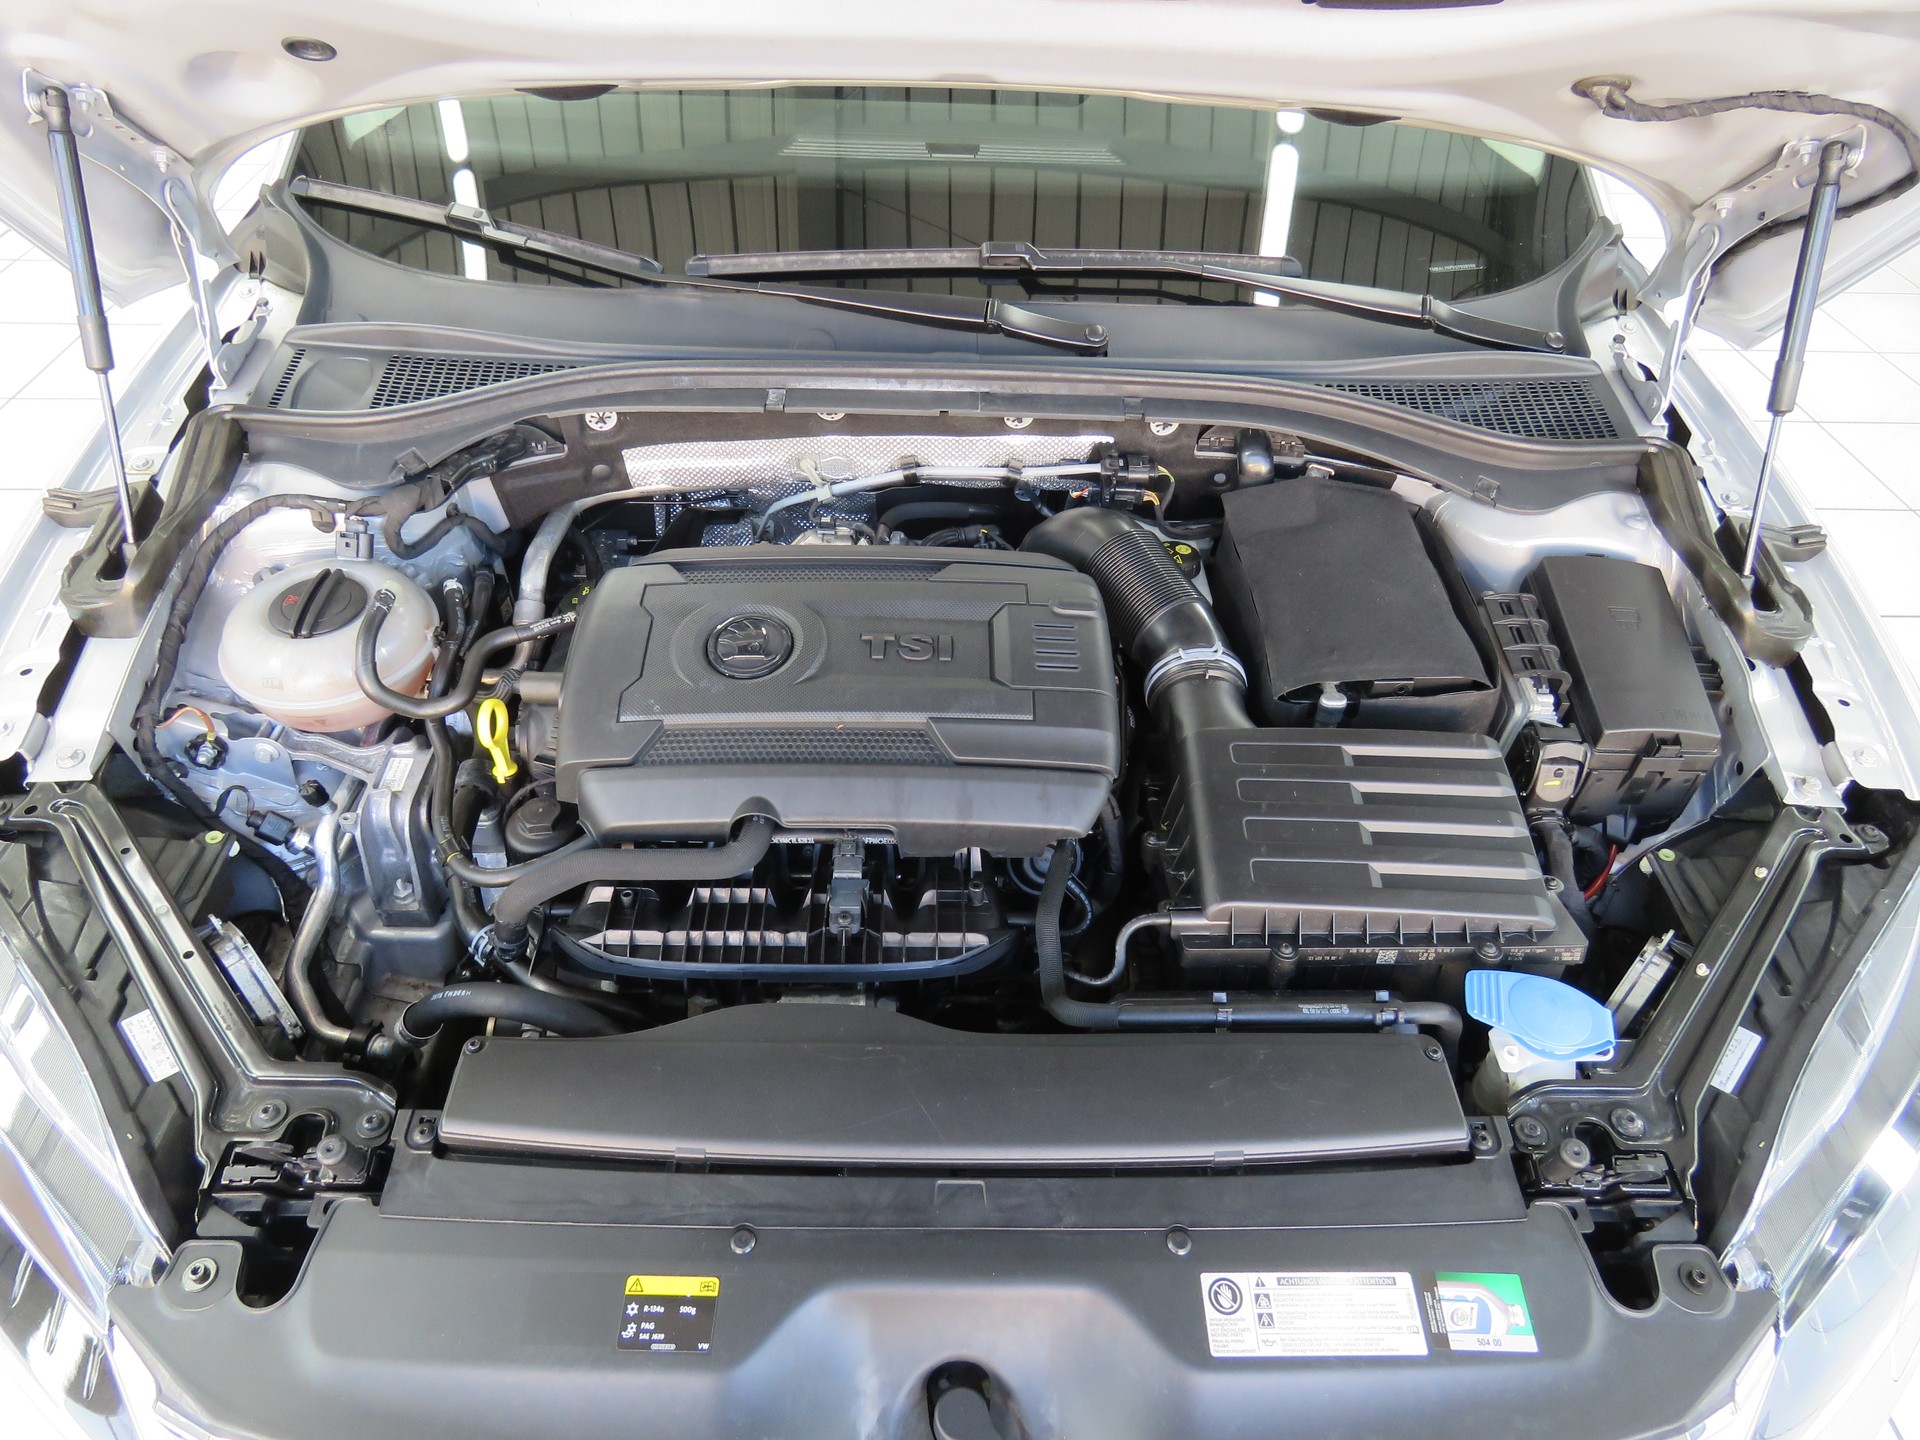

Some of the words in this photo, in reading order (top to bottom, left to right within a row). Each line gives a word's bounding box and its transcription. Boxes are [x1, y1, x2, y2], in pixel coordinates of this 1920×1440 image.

[859, 632, 954, 661] TSI
[643, 1304, 665, 1313] R-134a
[679, 1305, 697, 1315] 500g
[640, 1322, 655, 1330] PAG
[697, 1342, 710, 1350] VW
[1477, 1338, 1491, 1347] 504
[1493, 1339, 1503, 1347] 00
